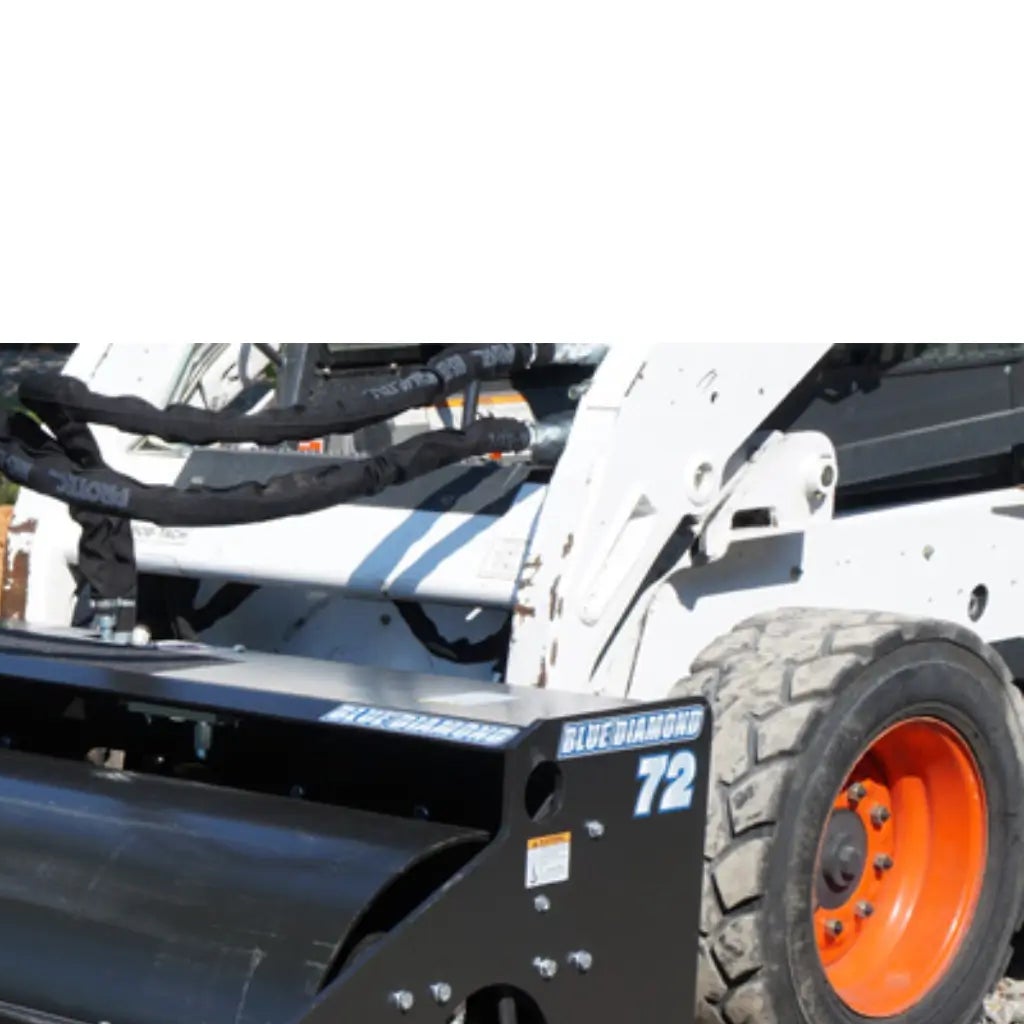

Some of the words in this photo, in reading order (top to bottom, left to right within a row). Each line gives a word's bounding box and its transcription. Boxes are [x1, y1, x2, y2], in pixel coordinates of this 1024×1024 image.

[561, 721, 613, 753] BLUE
[613, 709, 704, 746] DIAMOND
[633, 750, 696, 818] 72
